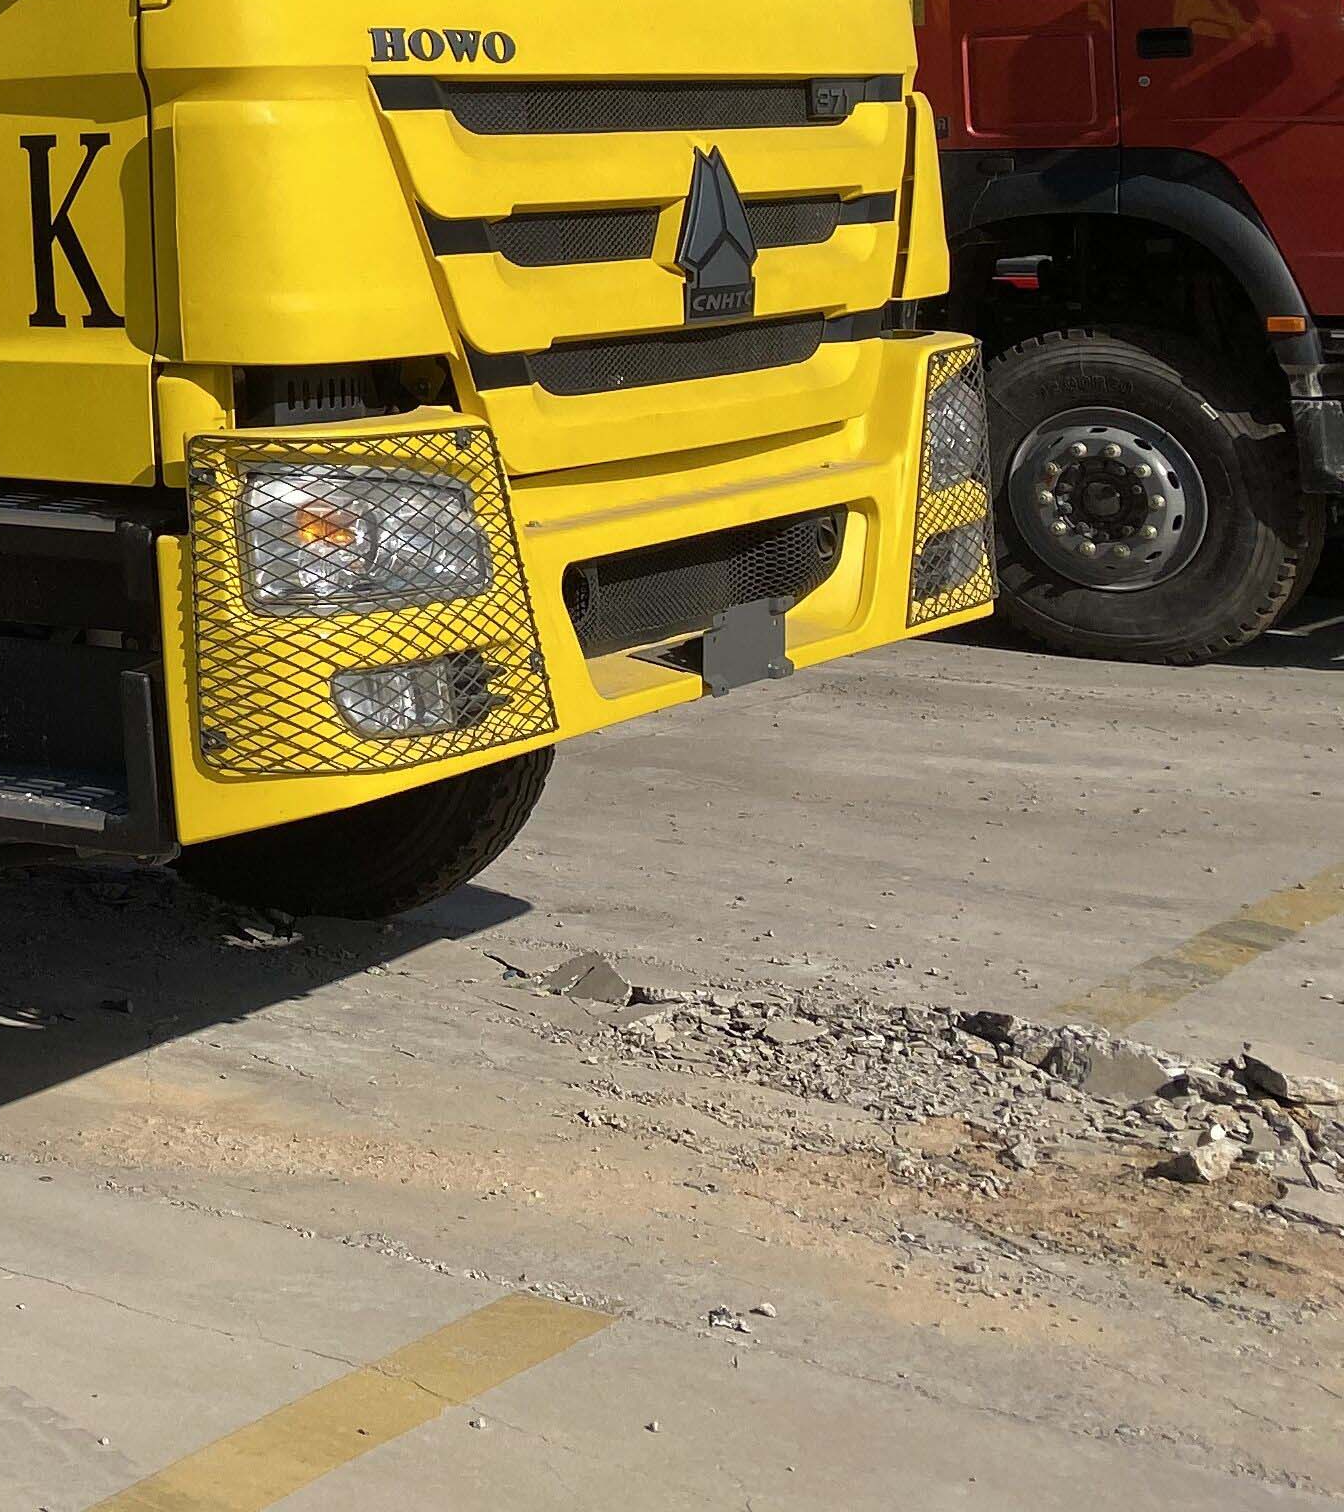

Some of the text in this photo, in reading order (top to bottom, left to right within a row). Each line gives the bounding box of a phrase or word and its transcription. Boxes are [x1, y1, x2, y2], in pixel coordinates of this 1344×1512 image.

[368, 28, 516, 64] HOWO
[816, 87, 847, 114] 371
[19, 133, 126, 328] K
[693, 290, 752, 312] CNHTC
